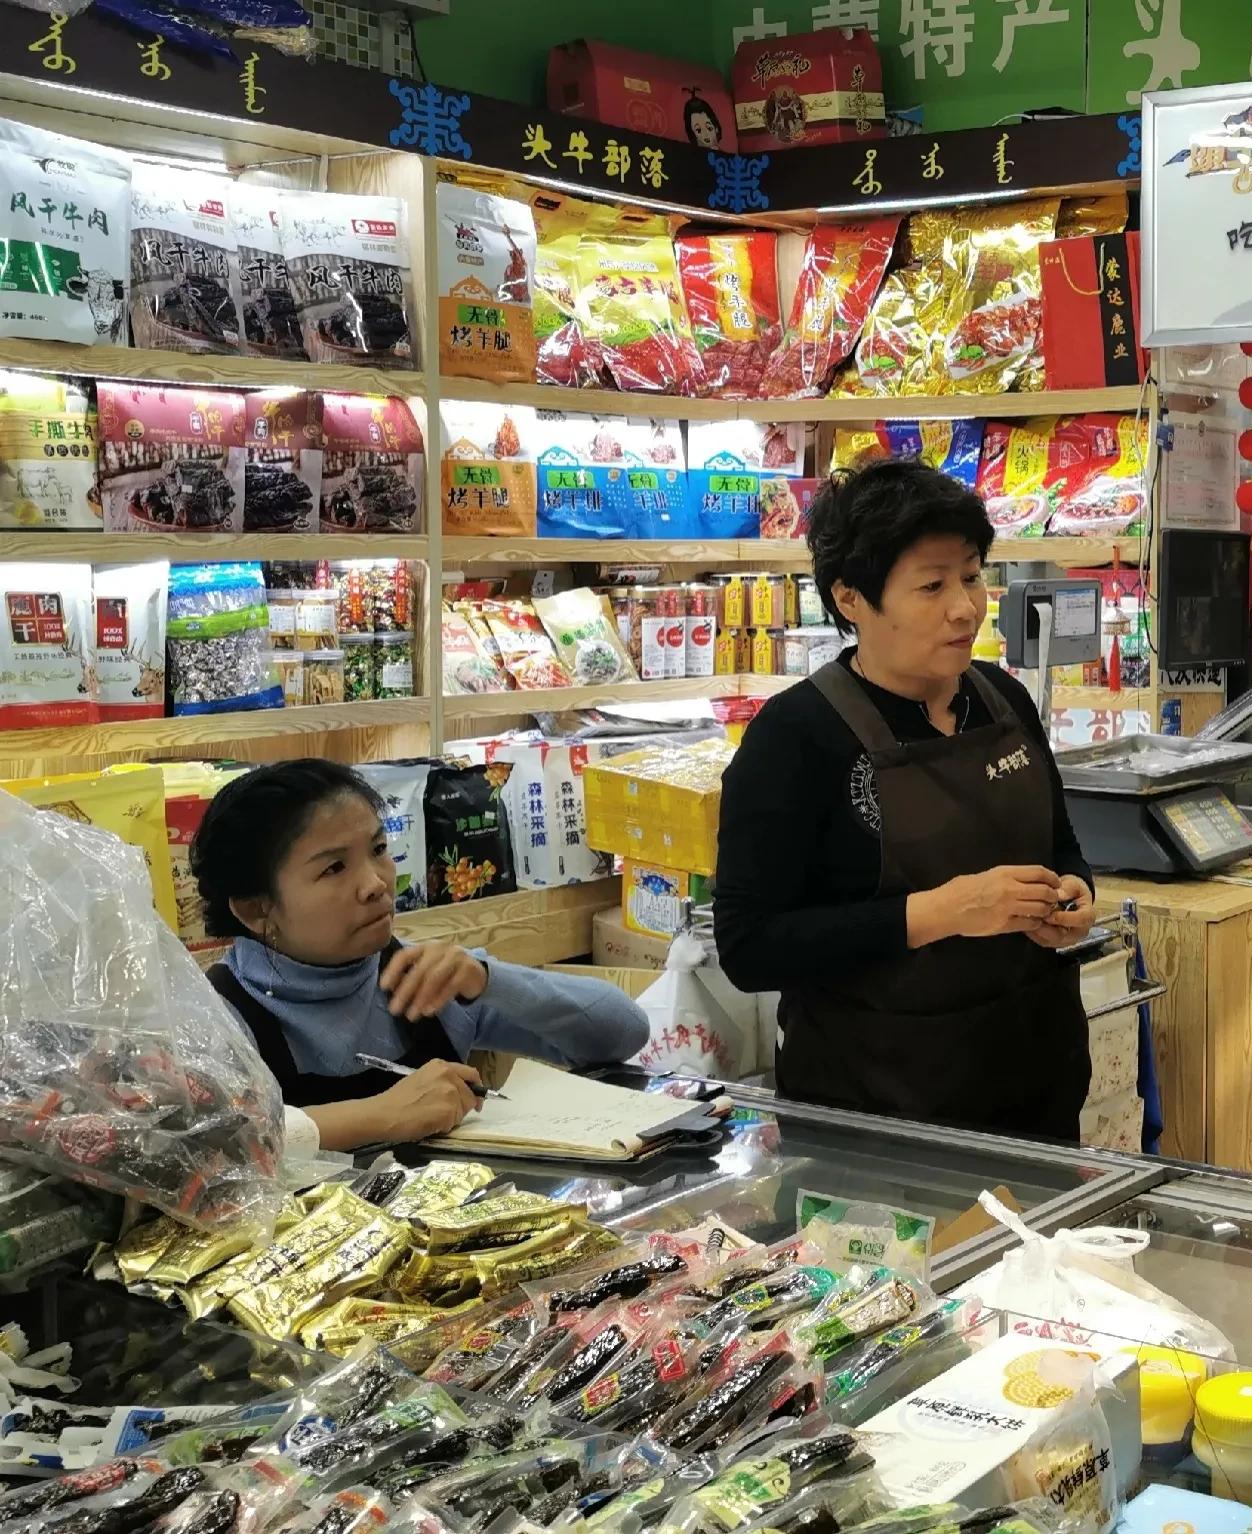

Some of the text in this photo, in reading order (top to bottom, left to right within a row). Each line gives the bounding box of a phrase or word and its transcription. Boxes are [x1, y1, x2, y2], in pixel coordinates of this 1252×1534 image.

[521, 123, 669, 189] 头牛部落
[10, 191, 109, 236] 风干牛肉
[139, 238, 230, 278] 风干牛肉
[306, 262, 404, 296] 风干牛肉
[1105, 256, 1129, 359] 蒙达鹿业
[450, 325, 513, 352] 烤羊腿
[528, 781, 547, 848] 森林采摘
[560, 780, 581, 847] 森林采摘
